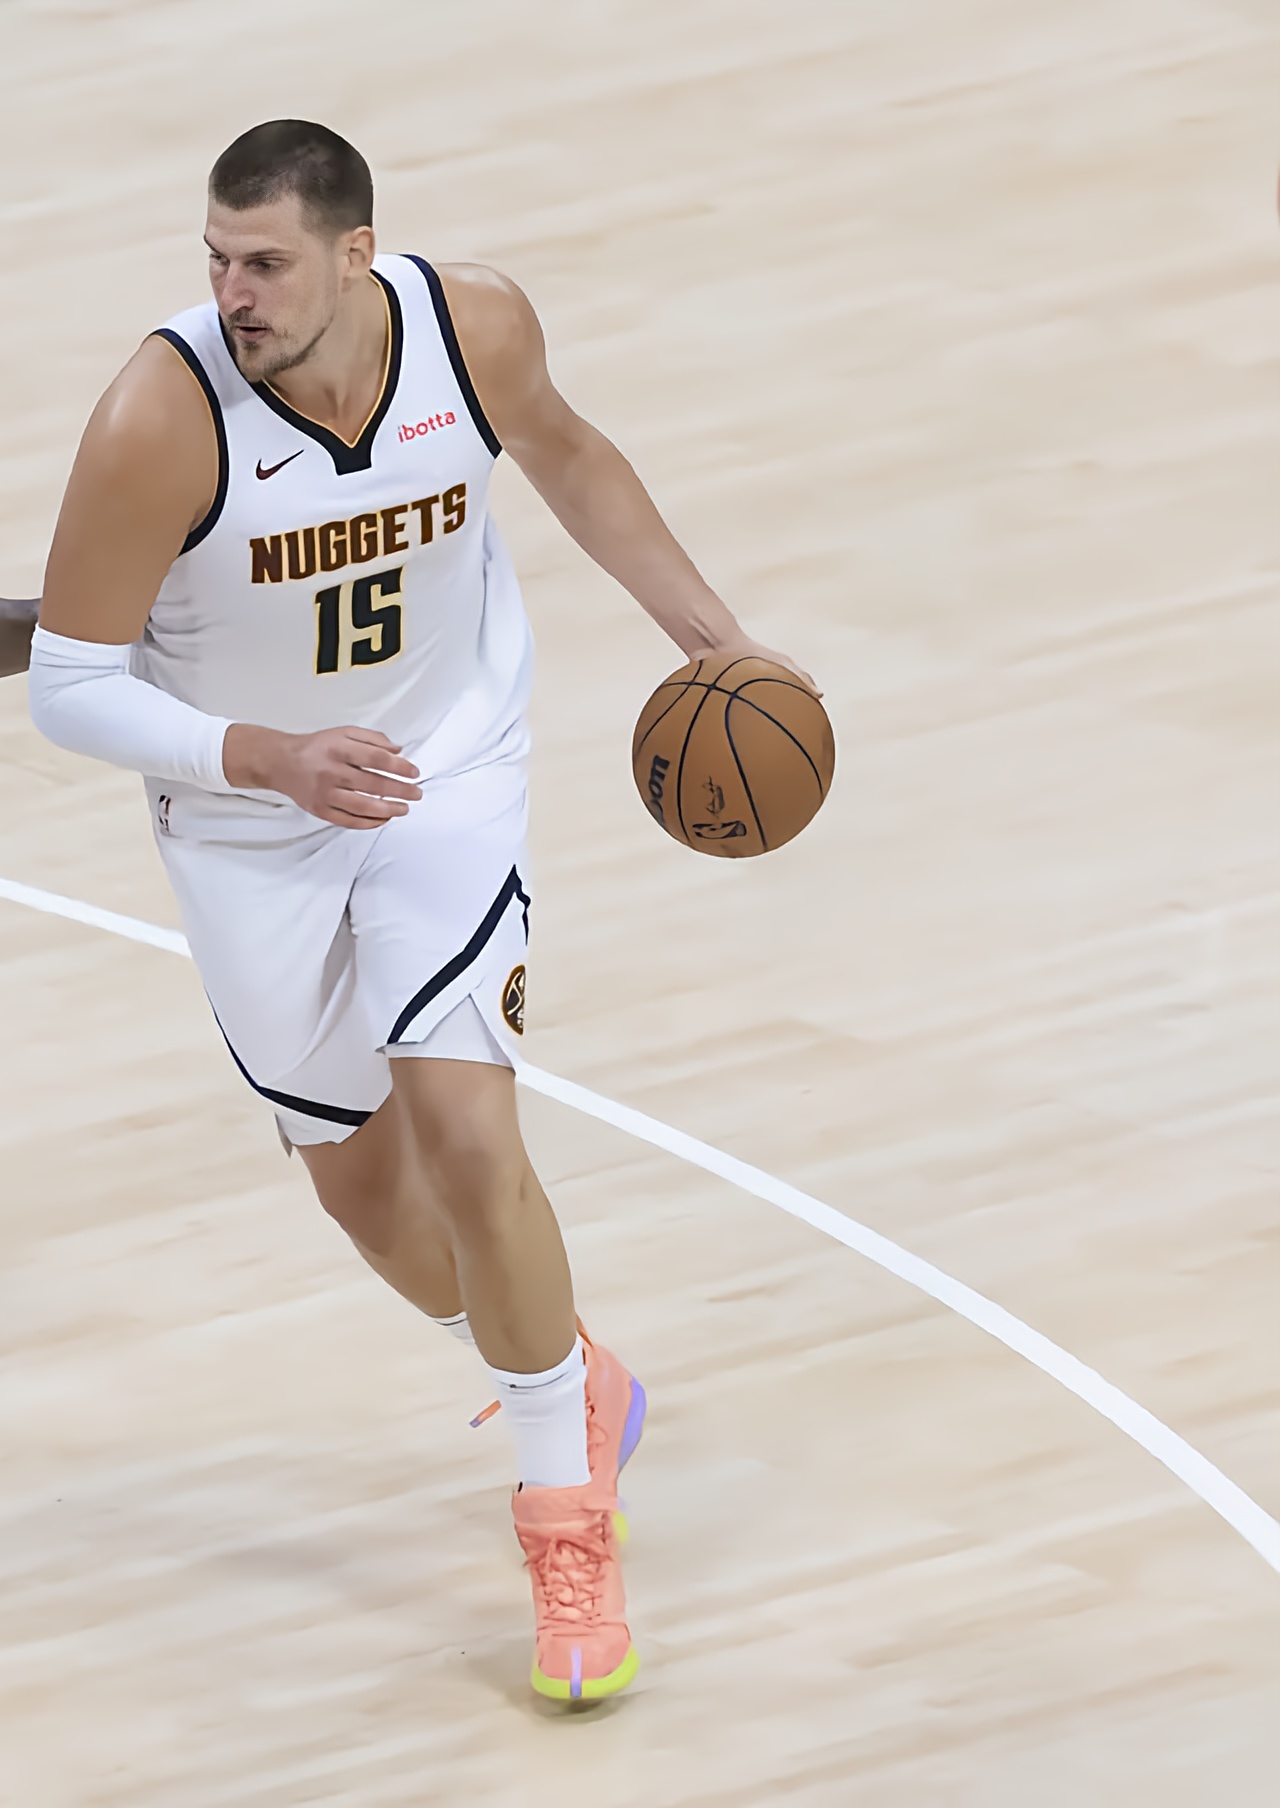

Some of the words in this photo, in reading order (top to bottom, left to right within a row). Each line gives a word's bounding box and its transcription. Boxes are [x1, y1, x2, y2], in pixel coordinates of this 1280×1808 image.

[397, 411, 457, 443] ibotta
[249, 482, 467, 584] NUGGETS
[313, 564, 404, 676] 15
